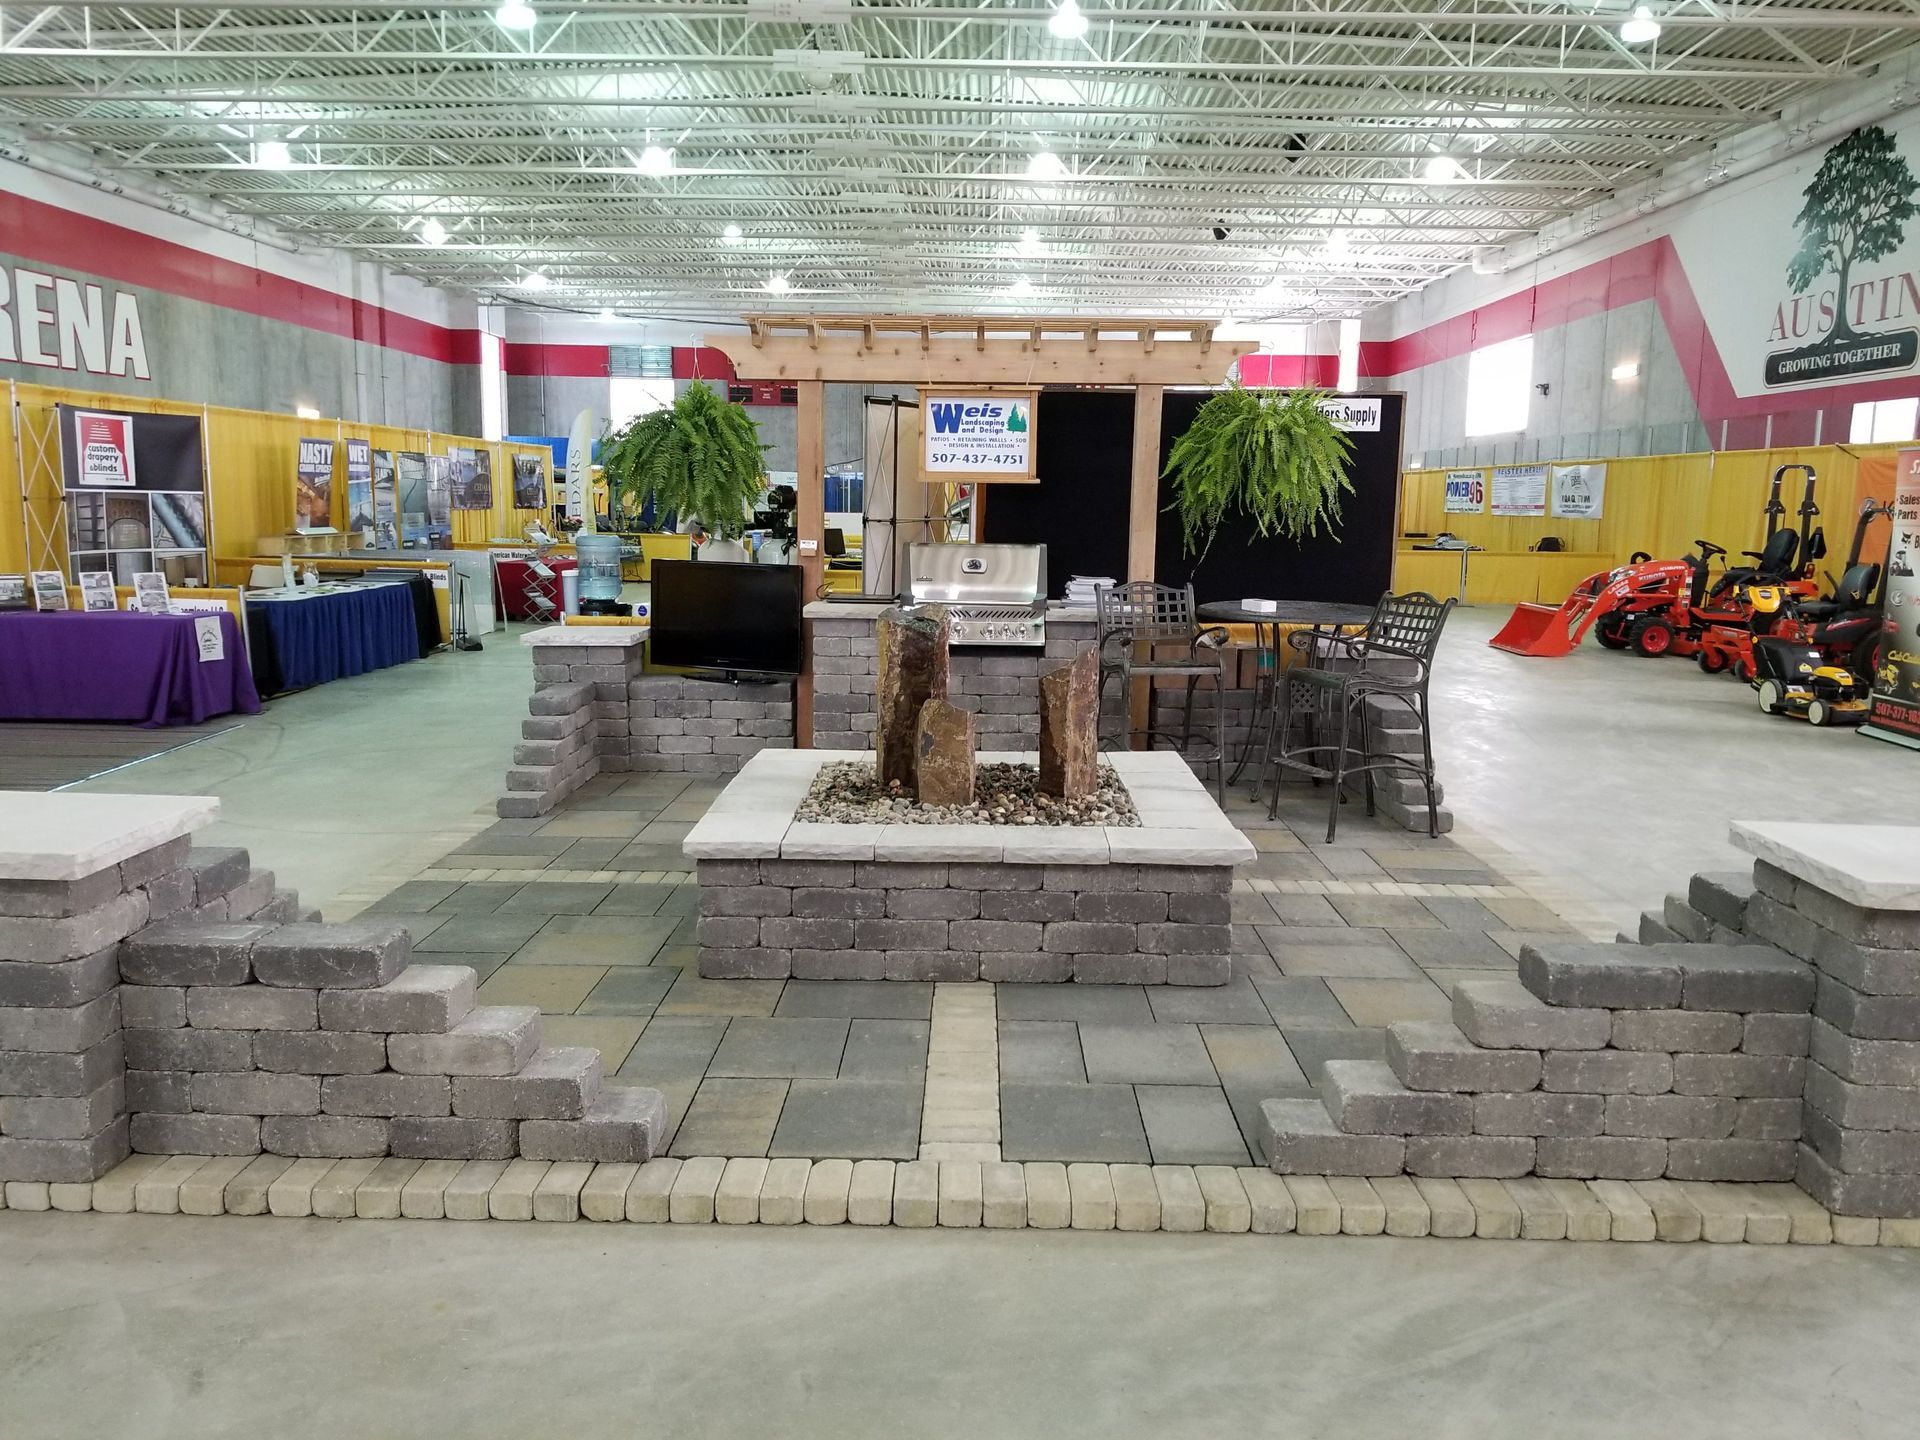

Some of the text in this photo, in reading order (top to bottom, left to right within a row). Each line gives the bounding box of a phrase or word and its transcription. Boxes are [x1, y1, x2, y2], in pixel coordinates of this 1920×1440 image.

[1778, 343, 1901, 374] GROWING TOGETHER
[931, 403, 1003, 433] Weis
[1343, 406, 1377, 426] Supply
[961, 419, 1005, 427] Landscaping
[979, 426, 1004, 435] Design
[88, 445, 117, 454] custom
[300, 442, 333, 465] NASTY
[348, 445, 368, 462] WET
[87, 453, 119, 463] drapery
[931, 453, 1023, 464] 507-437-4751
[1446, 481, 1469, 497] POWER
[1468, 480, 1483, 504] 96
[1897, 509, 1918, 520] Parts
[429, 572, 446, 581] Blinds
[1638, 572, 1666, 581] KUBOTA
